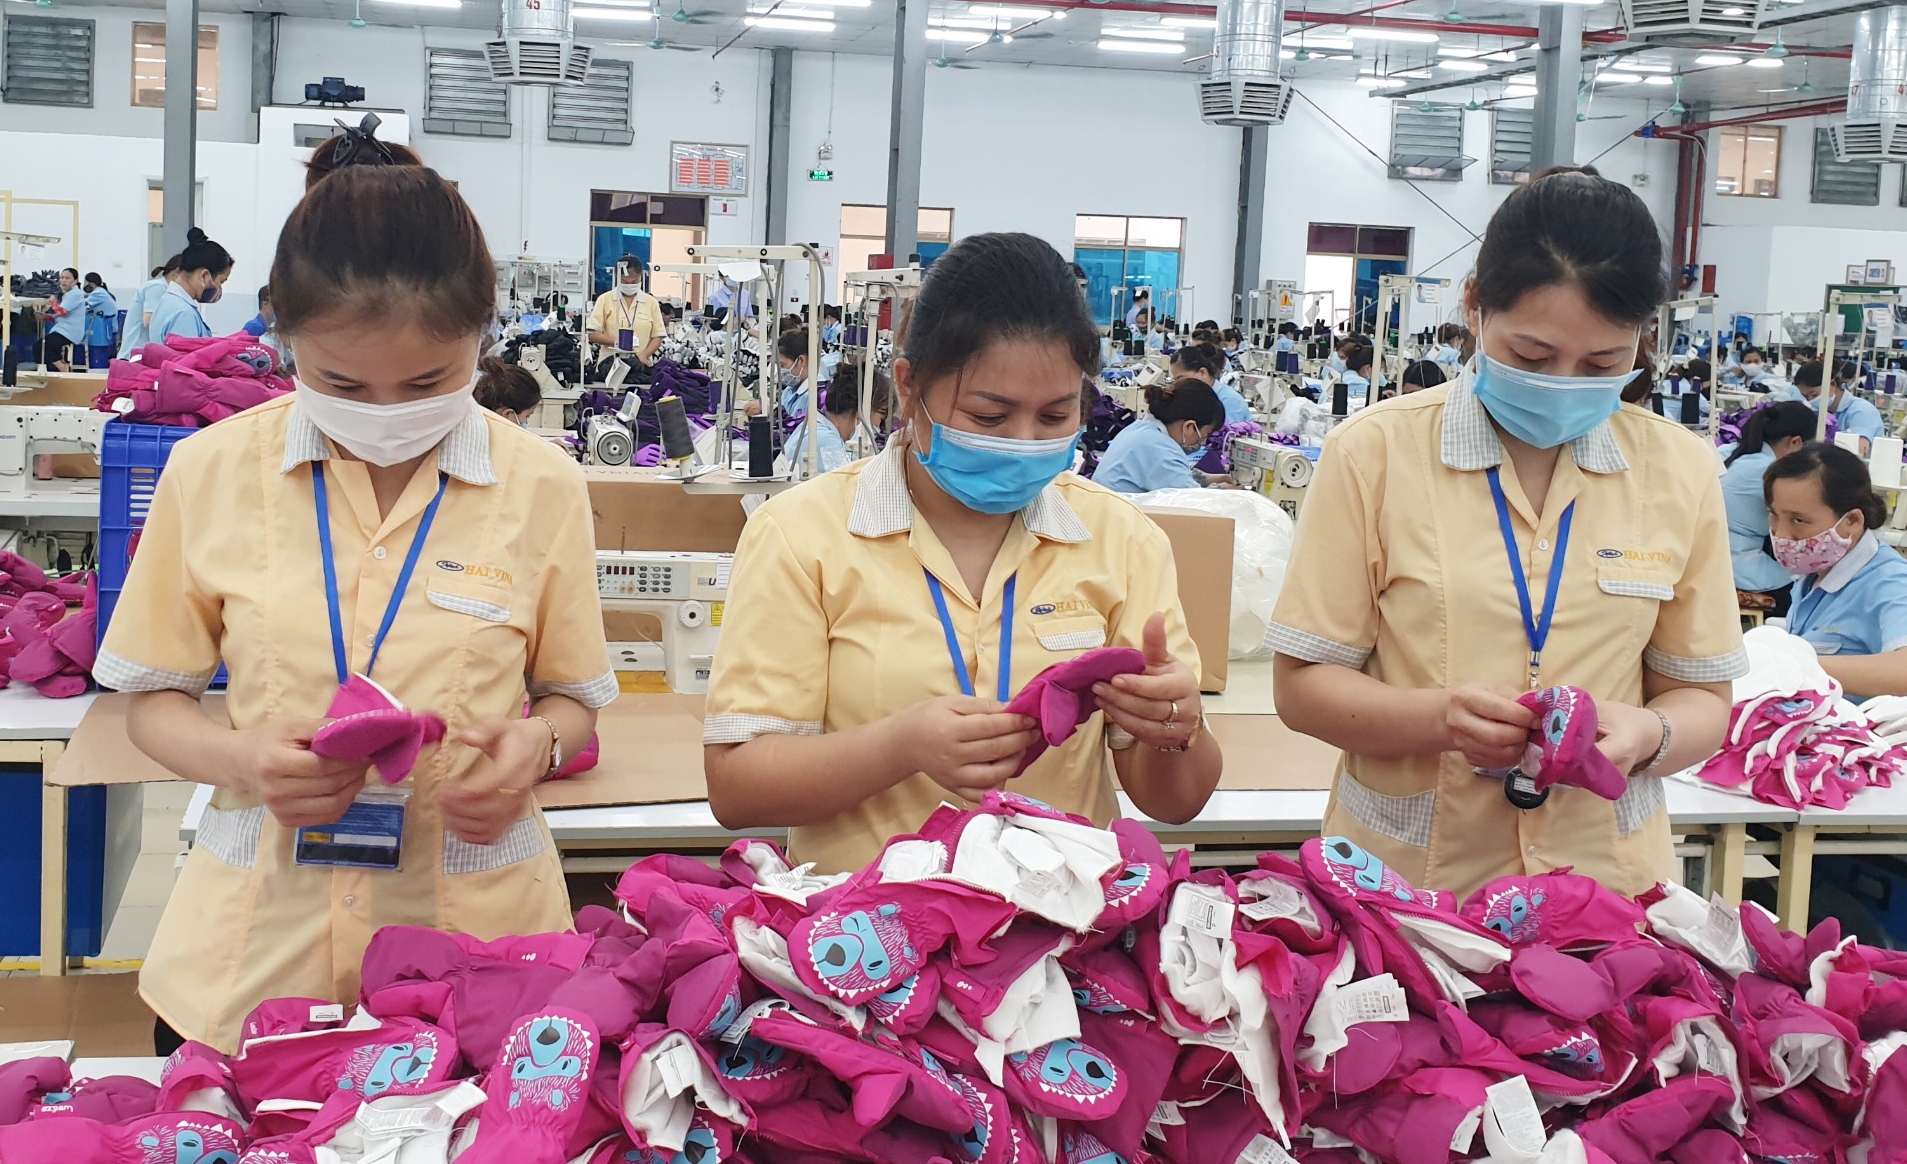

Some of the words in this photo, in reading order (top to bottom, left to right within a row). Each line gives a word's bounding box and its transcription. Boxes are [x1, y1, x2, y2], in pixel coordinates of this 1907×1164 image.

[526, 0, 540, 9] 45
[1623, 549, 1645, 561] HAI
[464, 564, 489, 577] HAI
[1056, 600, 1078, 613] HAI
